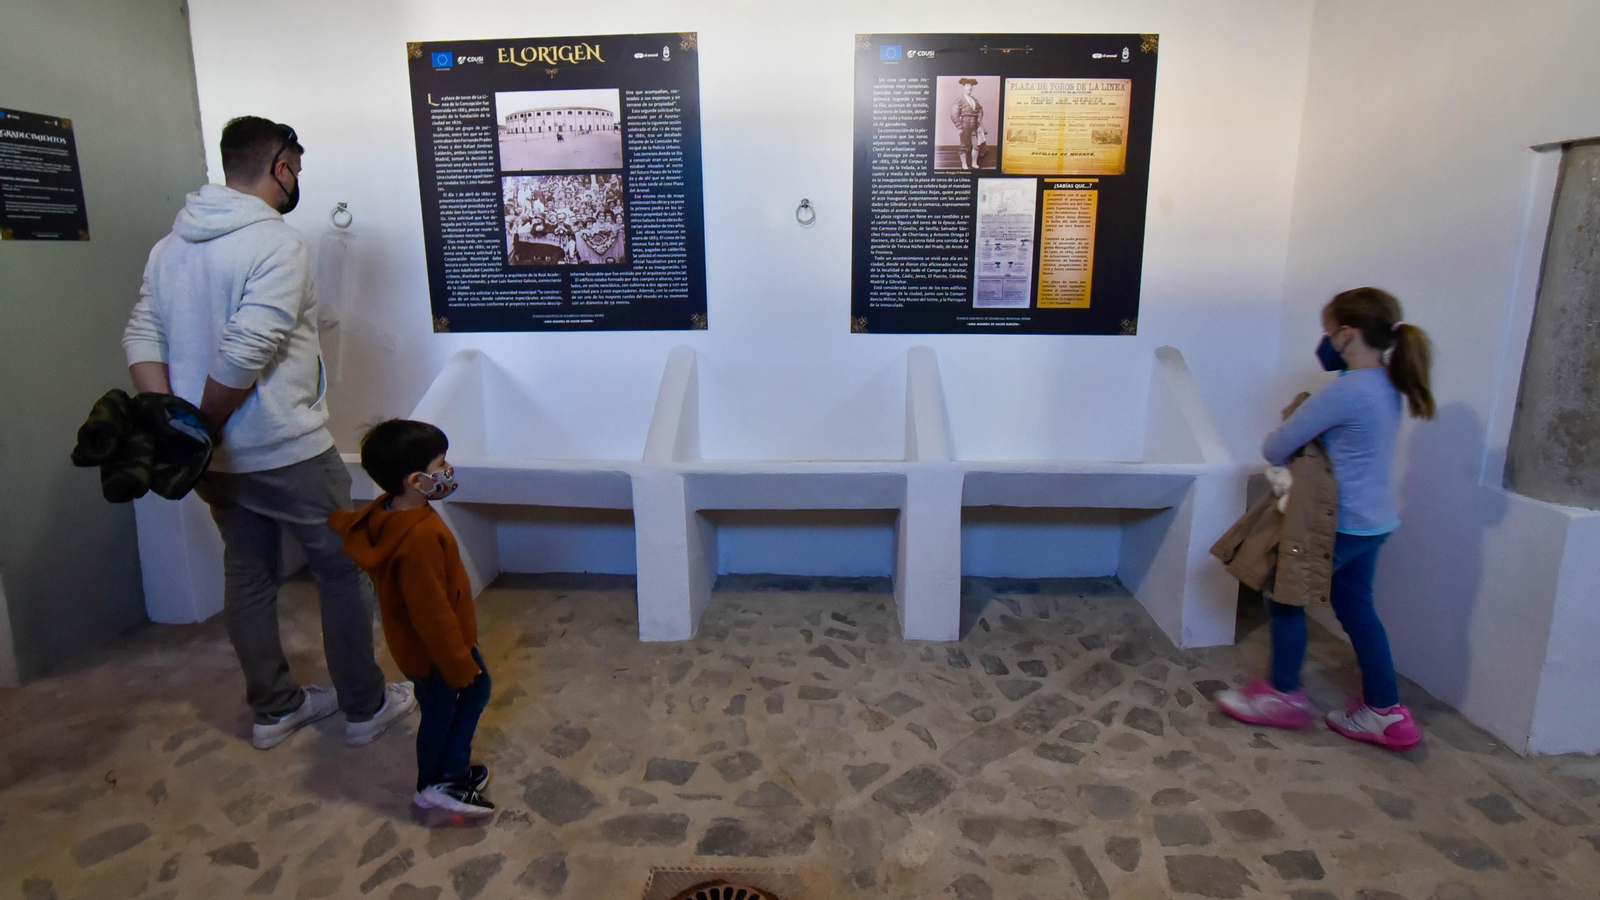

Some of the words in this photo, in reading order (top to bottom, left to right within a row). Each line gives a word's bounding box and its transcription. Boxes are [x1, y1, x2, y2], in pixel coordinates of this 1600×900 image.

[498, 47, 527, 67] EL
[520, 42, 605, 65] ORIGEN
[1010, 82, 1035, 91] PLAZA
[1037, 82, 1048, 91] DE
[1049, 82, 1075, 91] TOROS
[1076, 82, 1087, 91] DE
[1089, 82, 1100, 91] LA
[1101, 82, 1125, 92] LINEA
